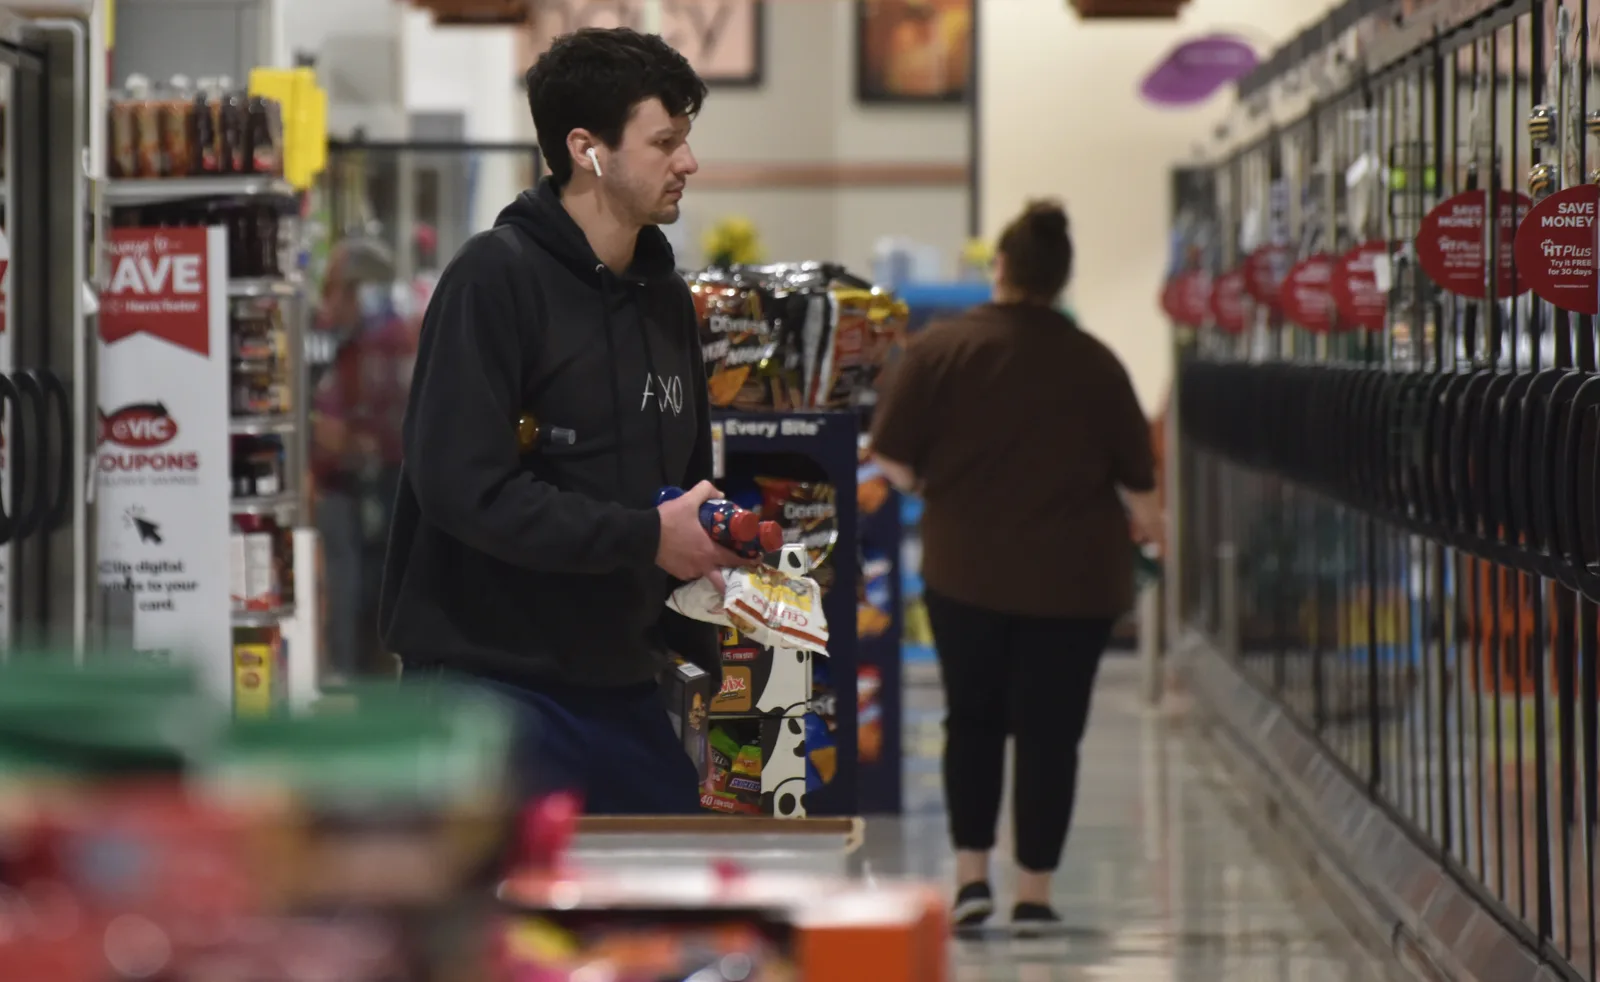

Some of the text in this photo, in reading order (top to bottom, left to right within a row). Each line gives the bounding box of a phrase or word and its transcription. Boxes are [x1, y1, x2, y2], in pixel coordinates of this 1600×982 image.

[1558, 202, 1594, 214] SAVE
[1438, 216, 1482, 228] MONEY
[1541, 216, 1594, 228] MONEY
[1551, 260, 1563, 268] Try
[107, 254, 201, 294] AVE
[1573, 268, 1593, 276] days
[725, 419, 777, 438] Every
[97, 453, 199, 471] OUPONS
[135, 559, 187, 576] digital
[719, 675, 746, 694] wix
[700, 795, 713, 805] 40
